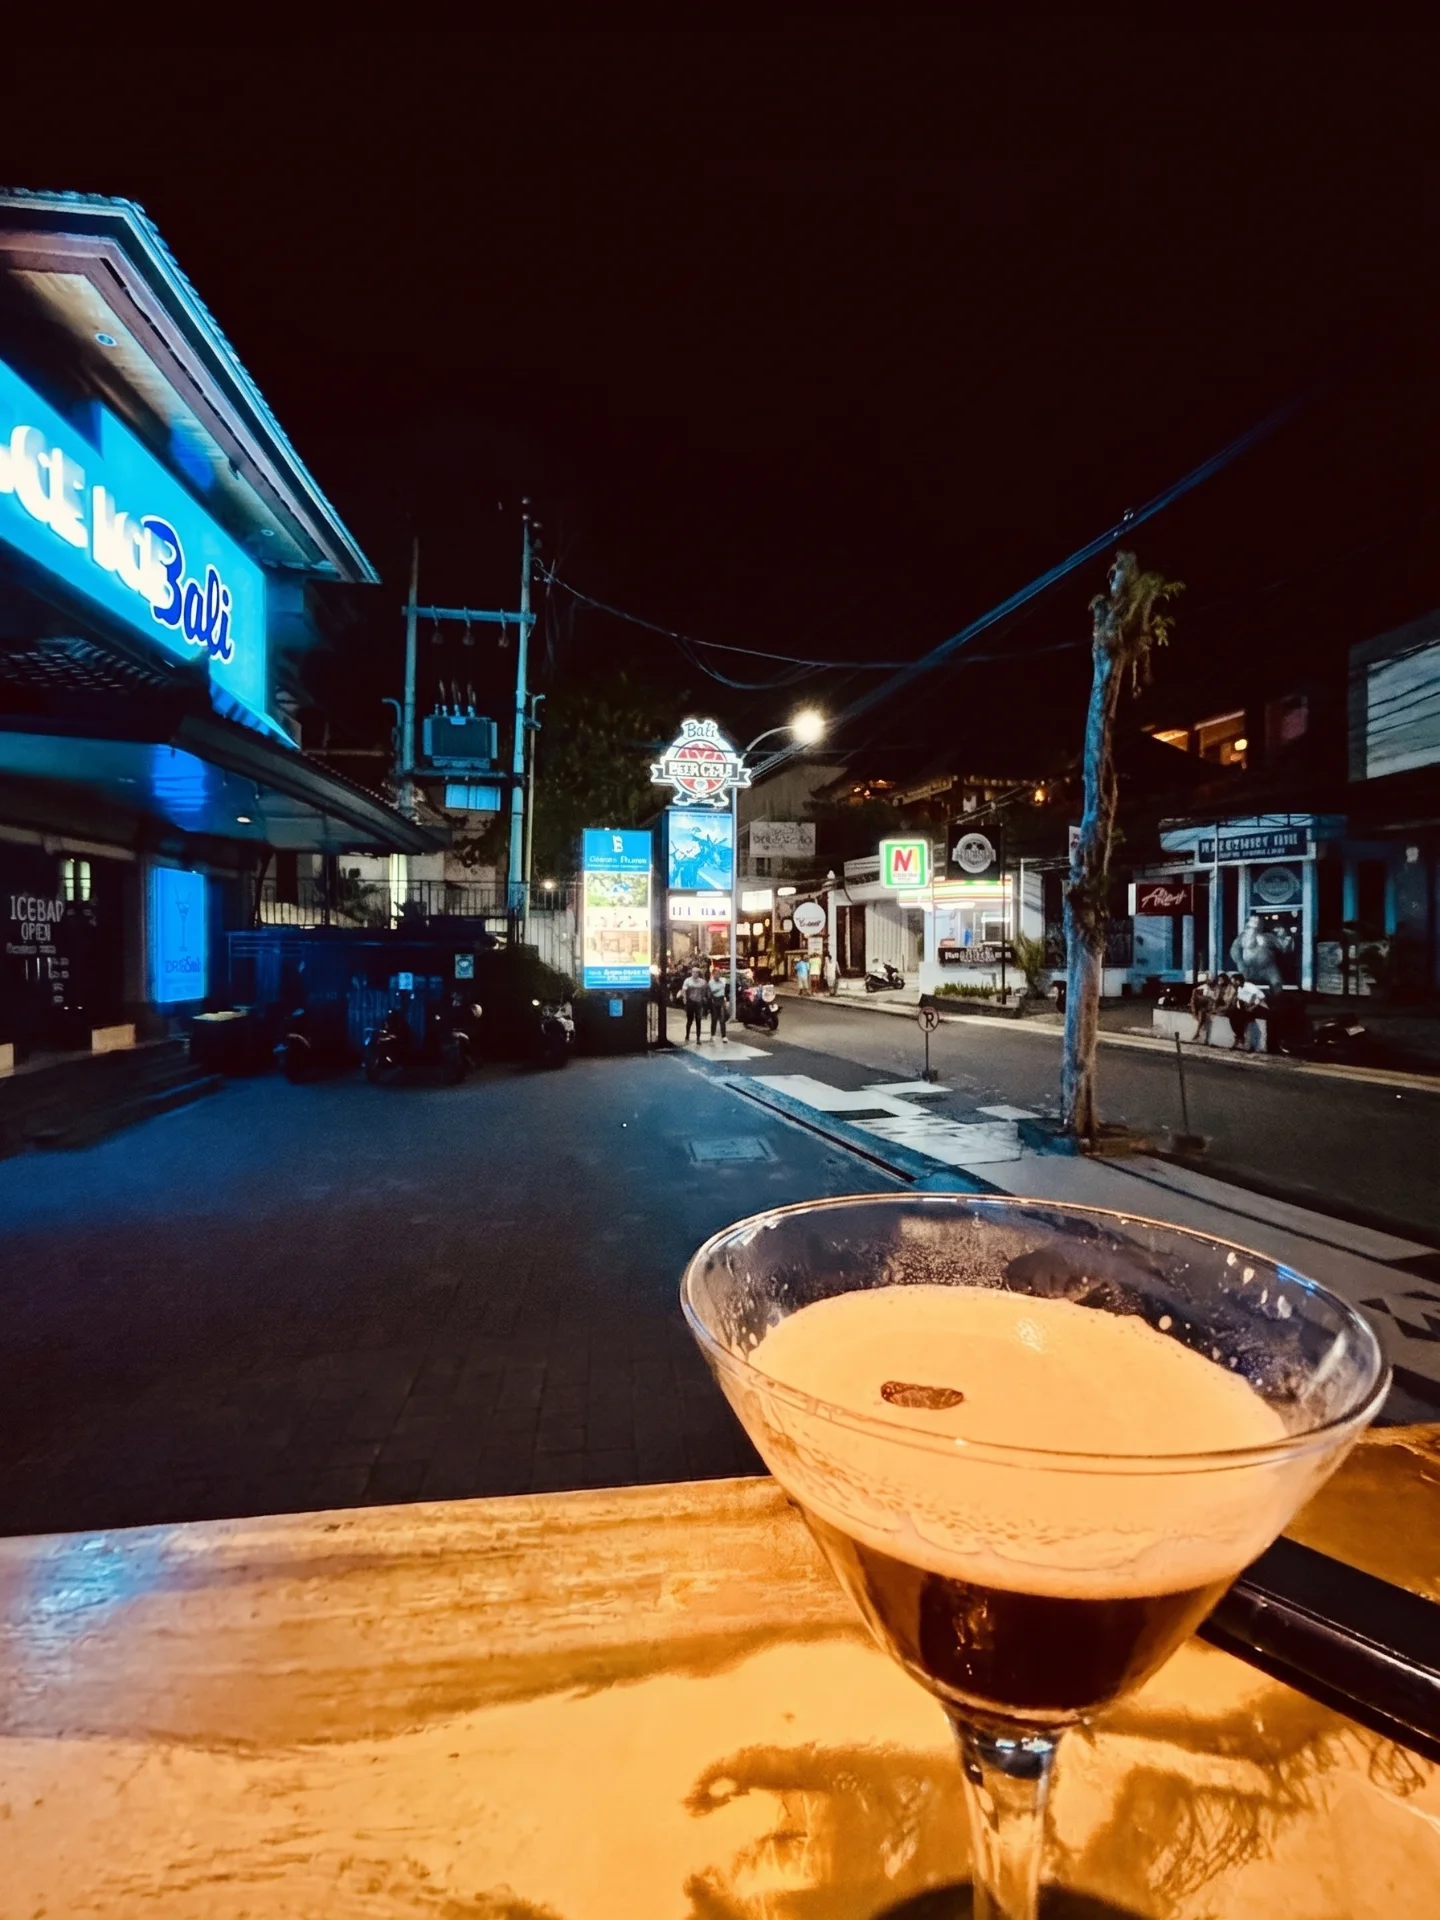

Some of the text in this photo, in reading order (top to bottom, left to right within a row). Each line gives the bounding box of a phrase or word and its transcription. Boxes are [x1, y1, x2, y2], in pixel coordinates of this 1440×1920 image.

[686, 723, 715, 738] Bali
[669, 762, 699, 776] BEER
[21, 922, 51, 942] OPEN
